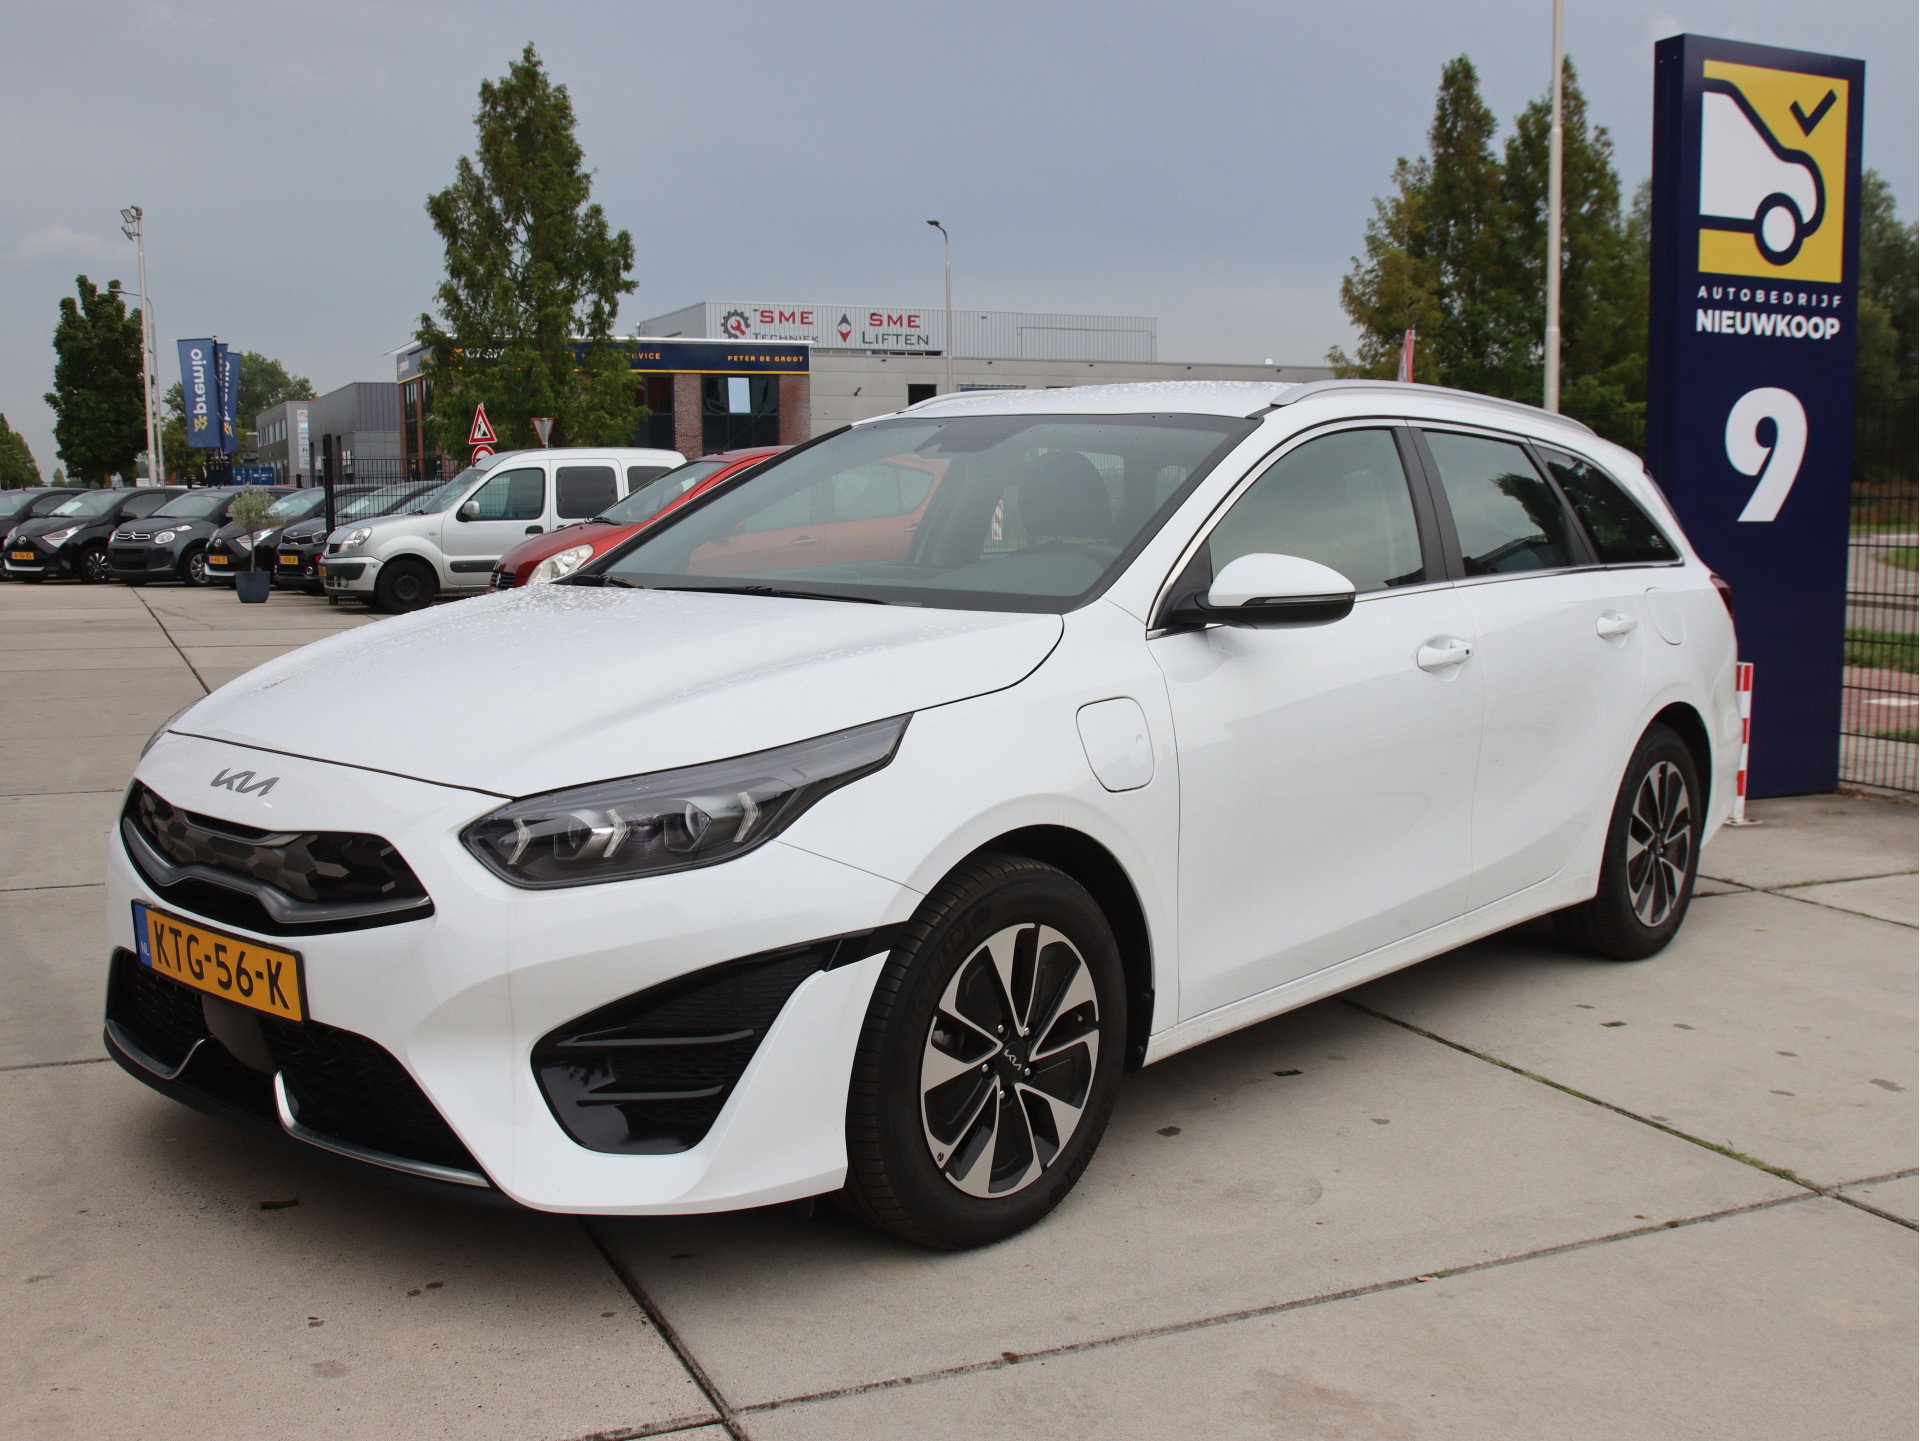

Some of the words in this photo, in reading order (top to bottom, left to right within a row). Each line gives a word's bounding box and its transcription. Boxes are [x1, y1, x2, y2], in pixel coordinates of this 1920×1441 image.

[1697, 285, 1842, 308] AUTOBEDRIJF
[759, 309, 813, 325] SME
[869, 312, 920, 328] SME
[1696, 308, 1841, 340] NIEUWKOOP
[862, 330, 929, 346] LIFTEN
[190, 348, 207, 414] premio
[1725, 386, 1808, 522] 9
[153, 919, 290, 1010] KTG-56-K
